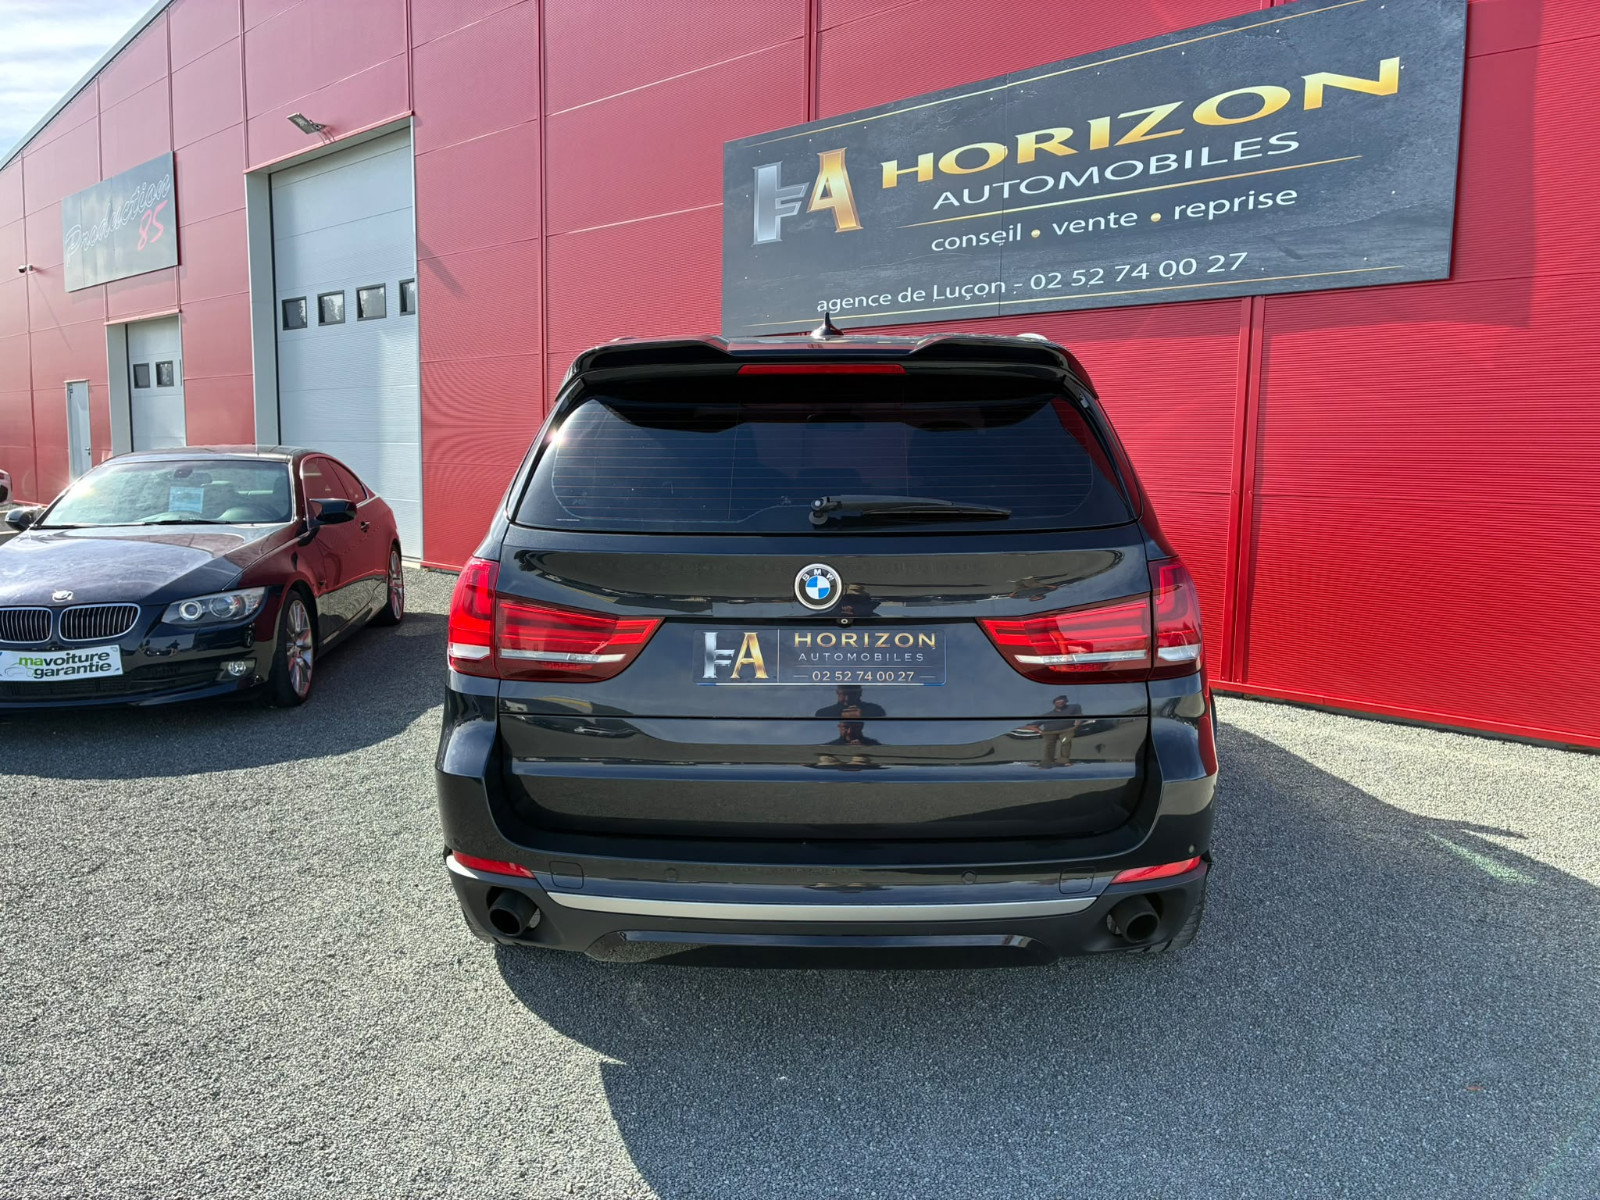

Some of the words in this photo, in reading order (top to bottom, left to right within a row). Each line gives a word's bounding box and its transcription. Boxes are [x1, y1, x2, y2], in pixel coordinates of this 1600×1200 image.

[880, 56, 1401, 189] HORIZON
[932, 131, 1300, 211] AUTOMOBILES
[137, 200, 168, 252] 85
[931, 223, 1023, 252] conseil
[1052, 211, 1139, 236] vente
[1173, 189, 1298, 221] reprise
[816, 292, 892, 314] agence
[897, 287, 927, 304] de
[932, 280, 1007, 302] Luçon
[1030, 272, 1063, 290] 02
[1071, 268, 1105, 286] 52
[1115, 262, 1150, 282] 74
[1158, 257, 1198, 277] 00
[1208, 251, 1249, 272] 27
[801, 568, 836, 582] BMW
[793, 632, 937, 648] HORIZON
[798, 653, 925, 662] AUTOMOBILES
[33, 661, 112, 679] garantie
[812, 671, 831, 682] 02
[834, 671, 853, 682] 52
[856, 671, 873, 682] 74
[876, 671, 895, 682] 00
[898, 671, 915, 682] 27
